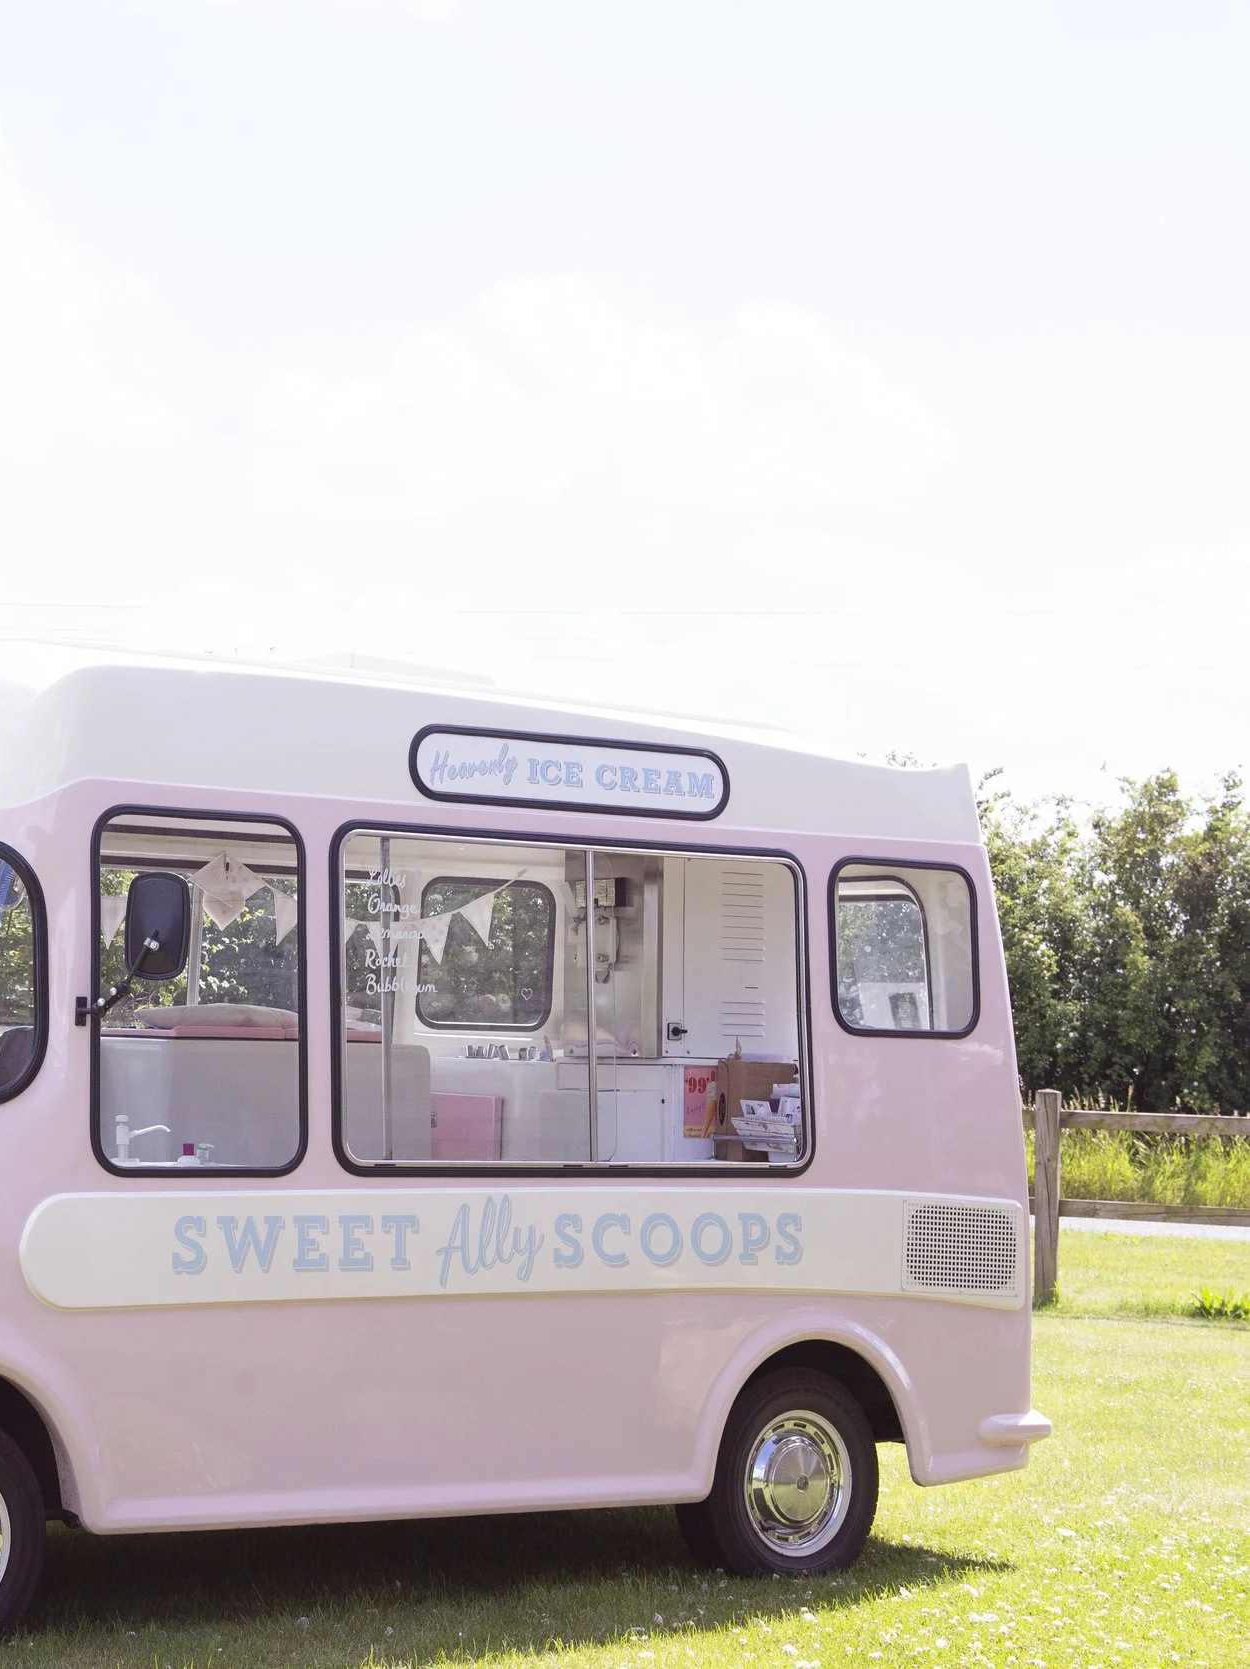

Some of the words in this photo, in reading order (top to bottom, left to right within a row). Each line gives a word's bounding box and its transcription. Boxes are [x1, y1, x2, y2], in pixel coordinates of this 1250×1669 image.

[429, 743, 518, 785] Heavenly
[527, 758, 583, 787] ICE
[595, 764, 715, 799] CREAM
[366, 868, 407, 888] Lollies
[367, 893, 418, 919] Orange
[365, 949, 411, 969] Rocket
[172, 1215, 420, 1274] SWEET
[435, 1193, 544, 1289] Ally
[553, 1212, 804, 1270] SCOOPS
